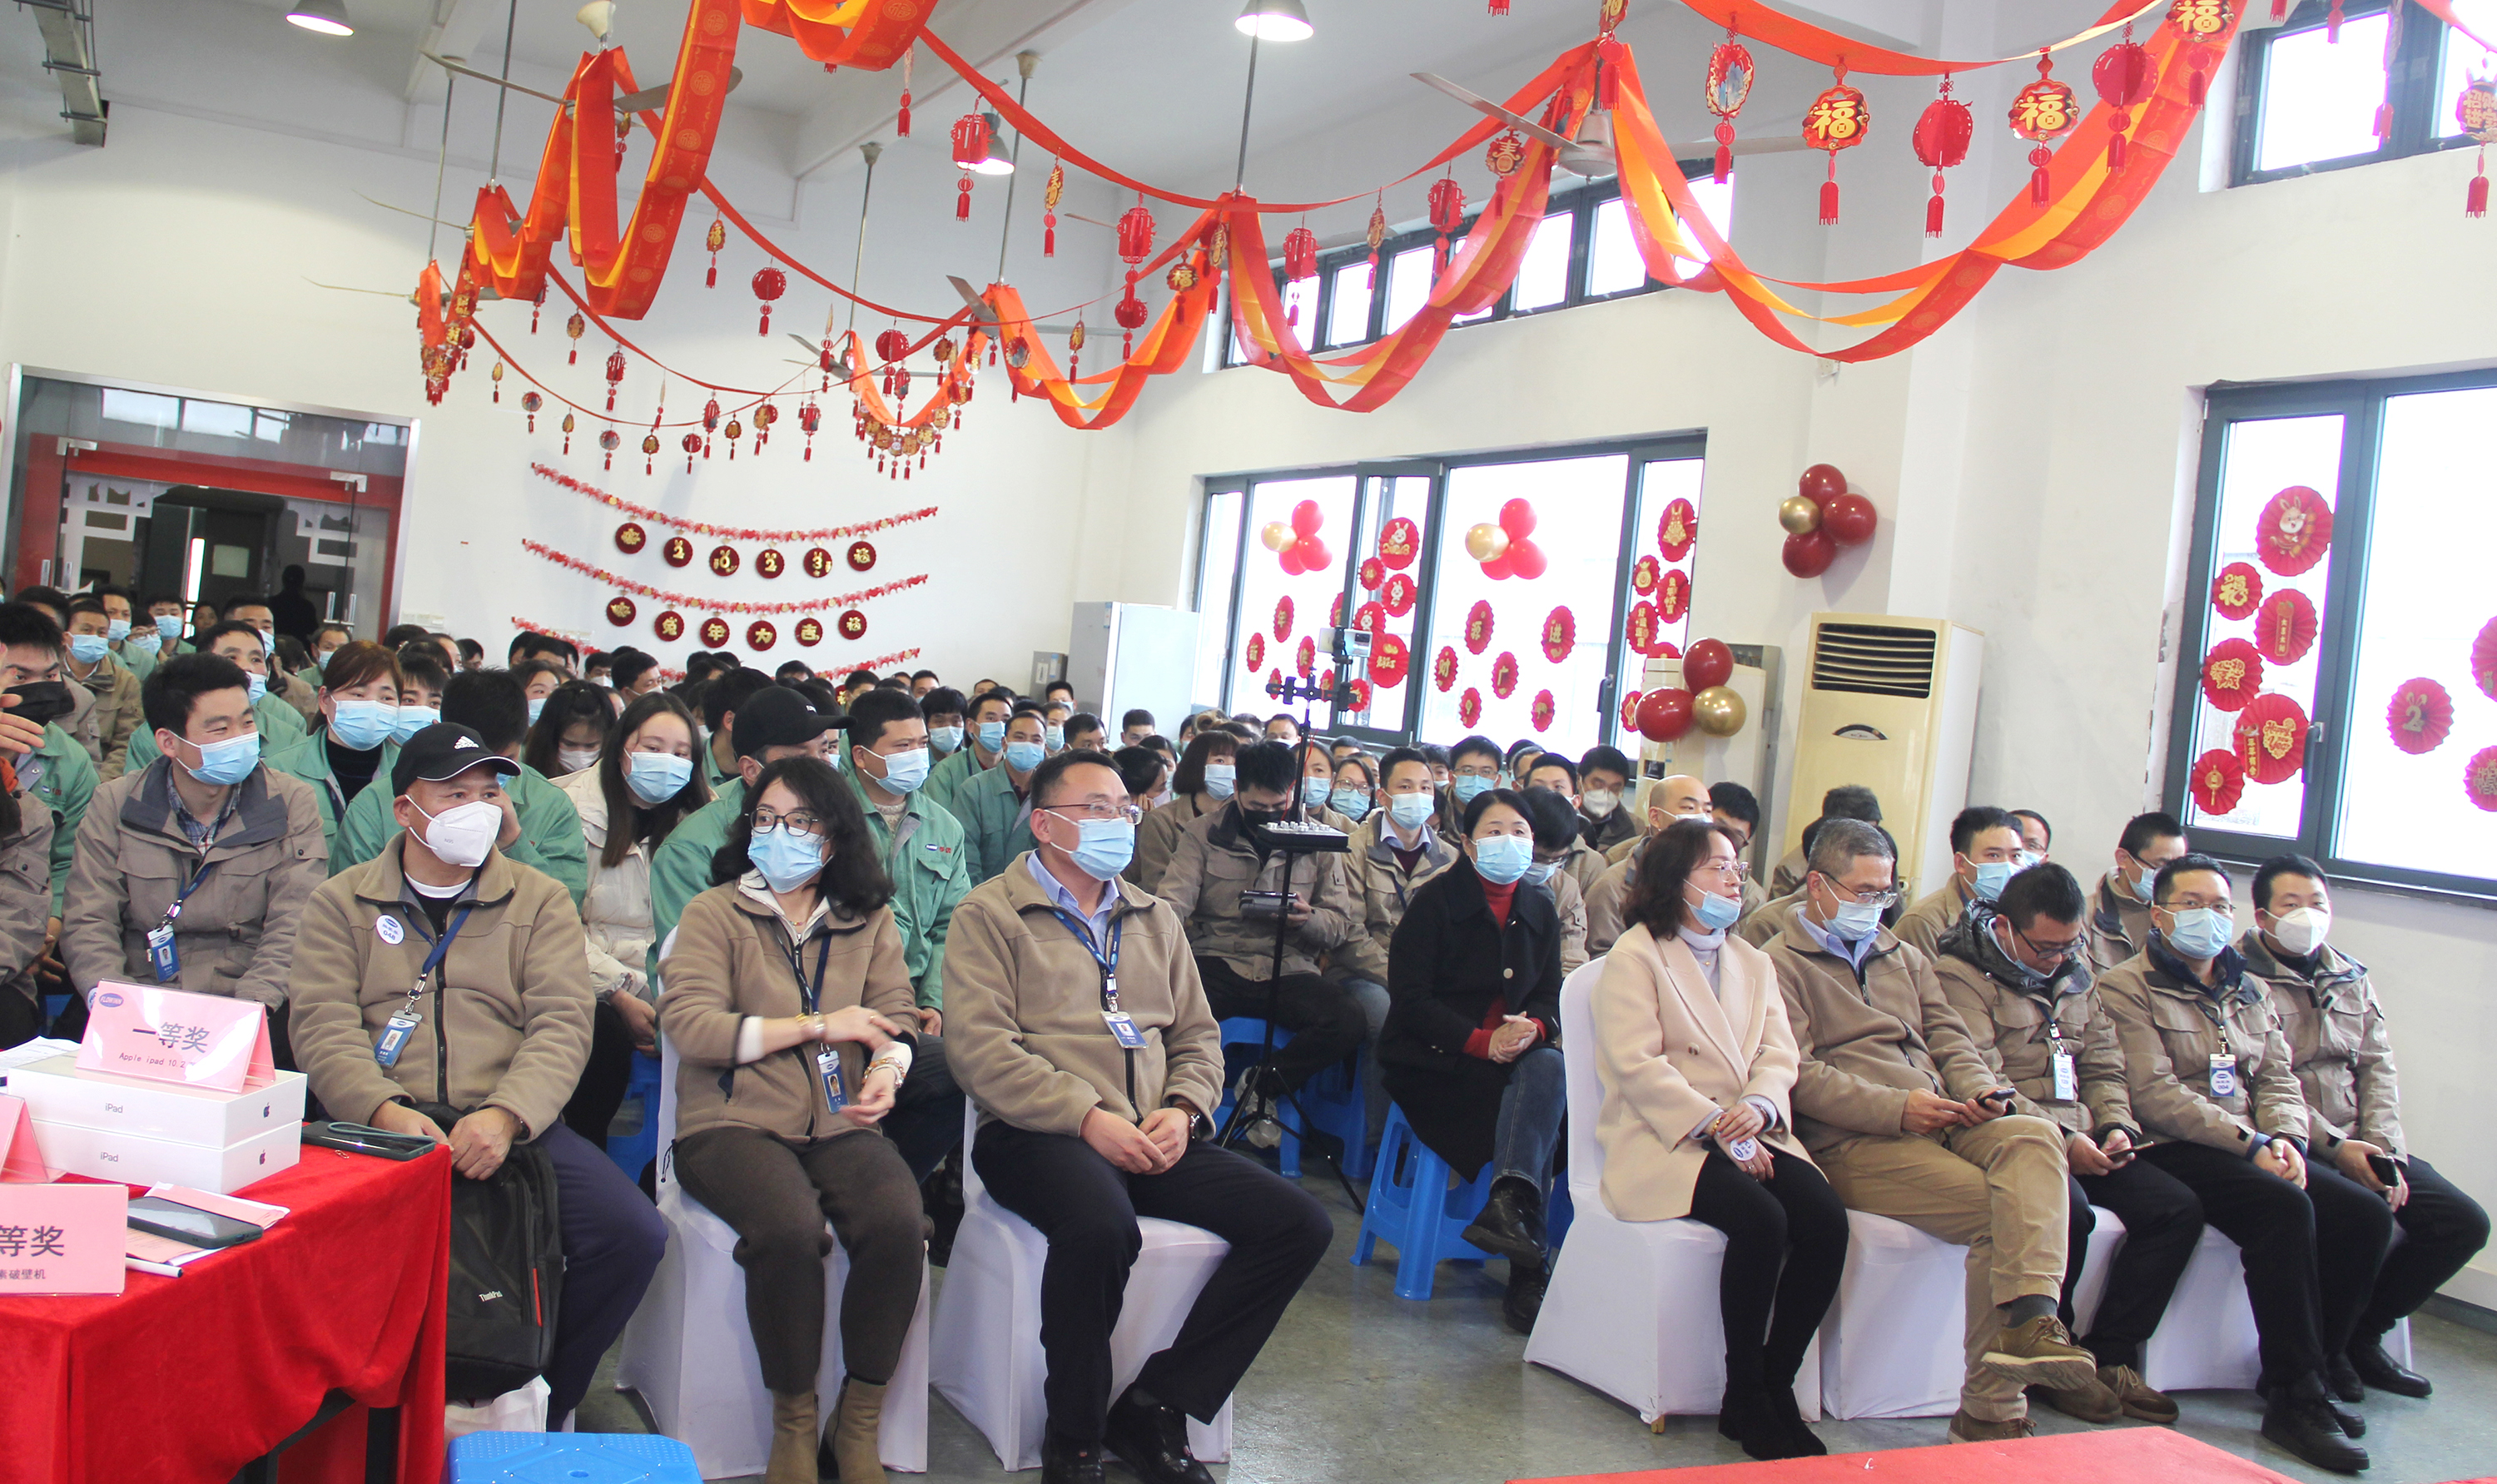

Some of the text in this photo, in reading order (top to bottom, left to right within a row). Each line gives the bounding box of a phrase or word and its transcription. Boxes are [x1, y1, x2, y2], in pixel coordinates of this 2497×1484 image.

[2175, 1, 2221, 33] 福
[1813, 100, 1857, 140] 福
[2018, 92, 2063, 133] 福
[1171, 269, 1194, 288] 福
[132, 1022, 210, 1054] 一等奖
[119, 1052, 142, 1063] Apple
[146, 1055, 165, 1066] ipad
[105, 1103, 124, 1114] iPad
[100, 1151, 119, 1163] iPad
[0, 1225, 64, 1258] 等奖
